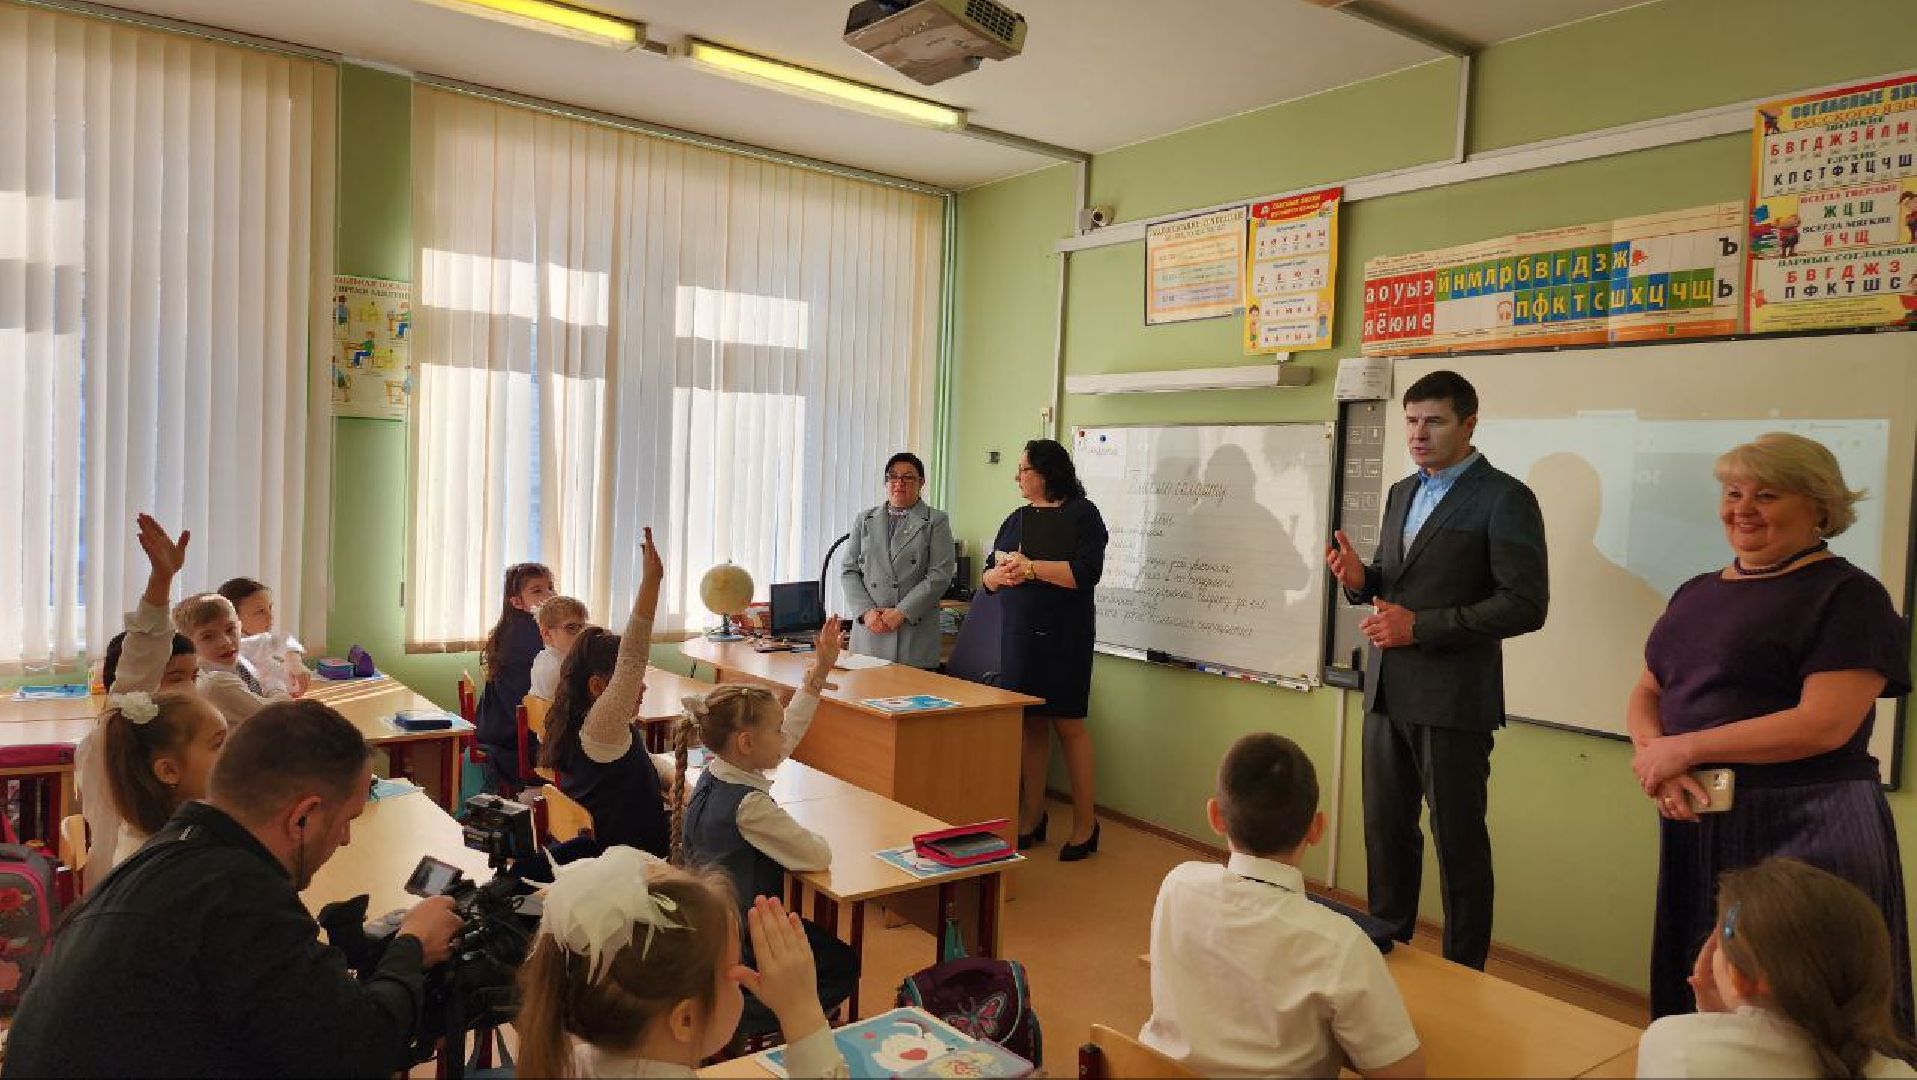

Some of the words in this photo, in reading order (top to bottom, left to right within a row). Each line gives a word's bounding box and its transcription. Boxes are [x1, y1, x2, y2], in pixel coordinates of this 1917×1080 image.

[1771, 145, 1779, 155] Б
[1786, 142, 1794, 154] В
[1801, 139, 1807, 151] Г
[1814, 137, 1823, 151] Д
[1830, 134, 1842, 145] Ж
[1851, 131, 1858, 142] З
[1866, 125, 1875, 139] Й
[1881, 125, 1890, 137] Л
[1897, 122, 1909, 134] М
[1774, 175, 1782, 185] К
[1789, 172, 1797, 184] П
[1804, 170, 1812, 181] С
[1819, 167, 1825, 178] Т
[1833, 166, 1843, 176] Ф
[1851, 163, 1859, 173] Х
[1866, 160, 1875, 174] Ц
[1882, 157, 1890, 169] Ч
[1899, 154, 1911, 167] Ш
[1824, 206, 1836, 218] Ж
[1843, 203, 1852, 217] Ц
[1860, 200, 1873, 214] Ш
[1786, 271, 1797, 283] Б
[1807, 269, 1816, 280] В
[1825, 268, 1834, 280] Г
[1842, 265, 1854, 280] Д
[1863, 263, 1879, 275] Ж
[1890, 260, 1899, 272] З
[1785, 286, 1795, 298] П
[1804, 284, 1818, 296] Ф
[1827, 283, 1836, 295] К
[1845, 281, 1854, 292] Т
[1863, 278, 1879, 292] Ш
[1890, 277, 1901, 289] С
